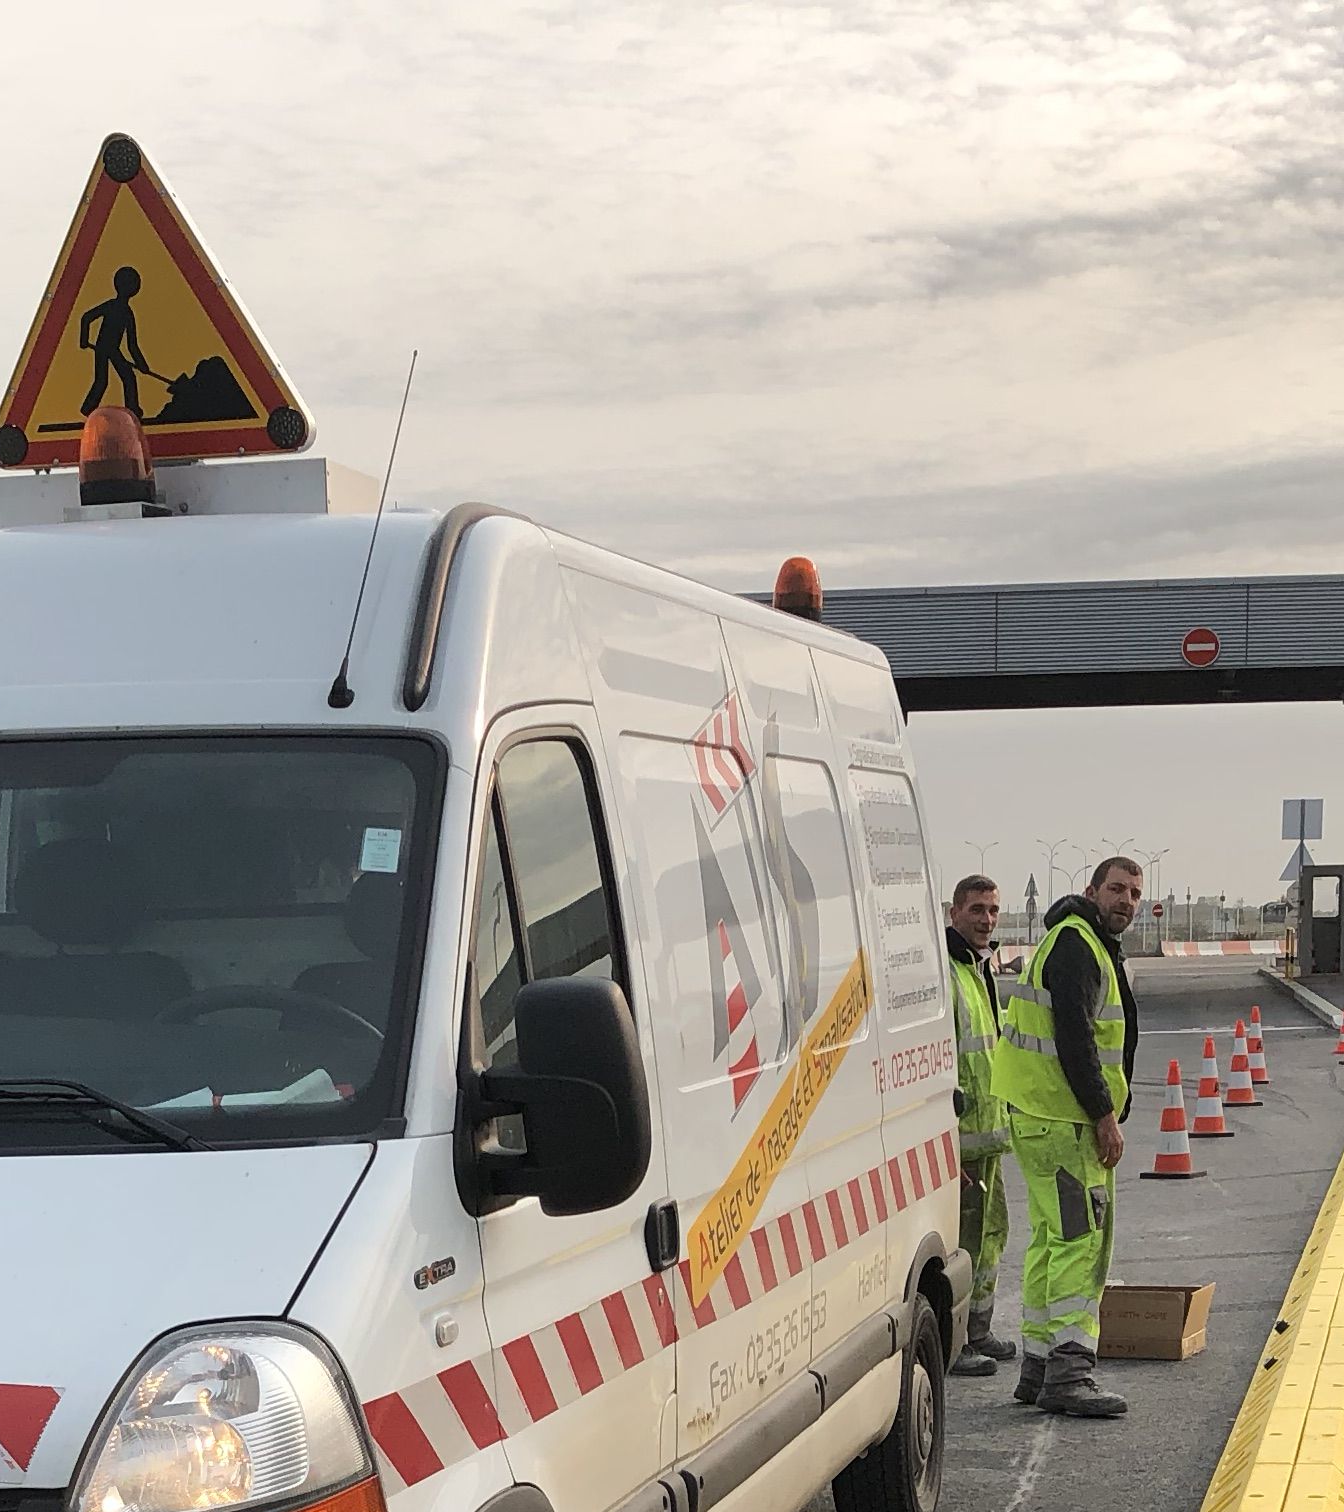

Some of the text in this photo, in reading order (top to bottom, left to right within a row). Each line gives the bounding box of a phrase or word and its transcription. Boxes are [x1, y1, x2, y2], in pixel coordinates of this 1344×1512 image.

[699, 1187, 743, 1283] Atelier
[746, 1159, 761, 1207] de
[758, 1088, 804, 1180] Traçage
[803, 1060, 815, 1106] et
[418, 1261, 454, 1285] EXTRA
[709, 1360, 737, 1408] Fax
